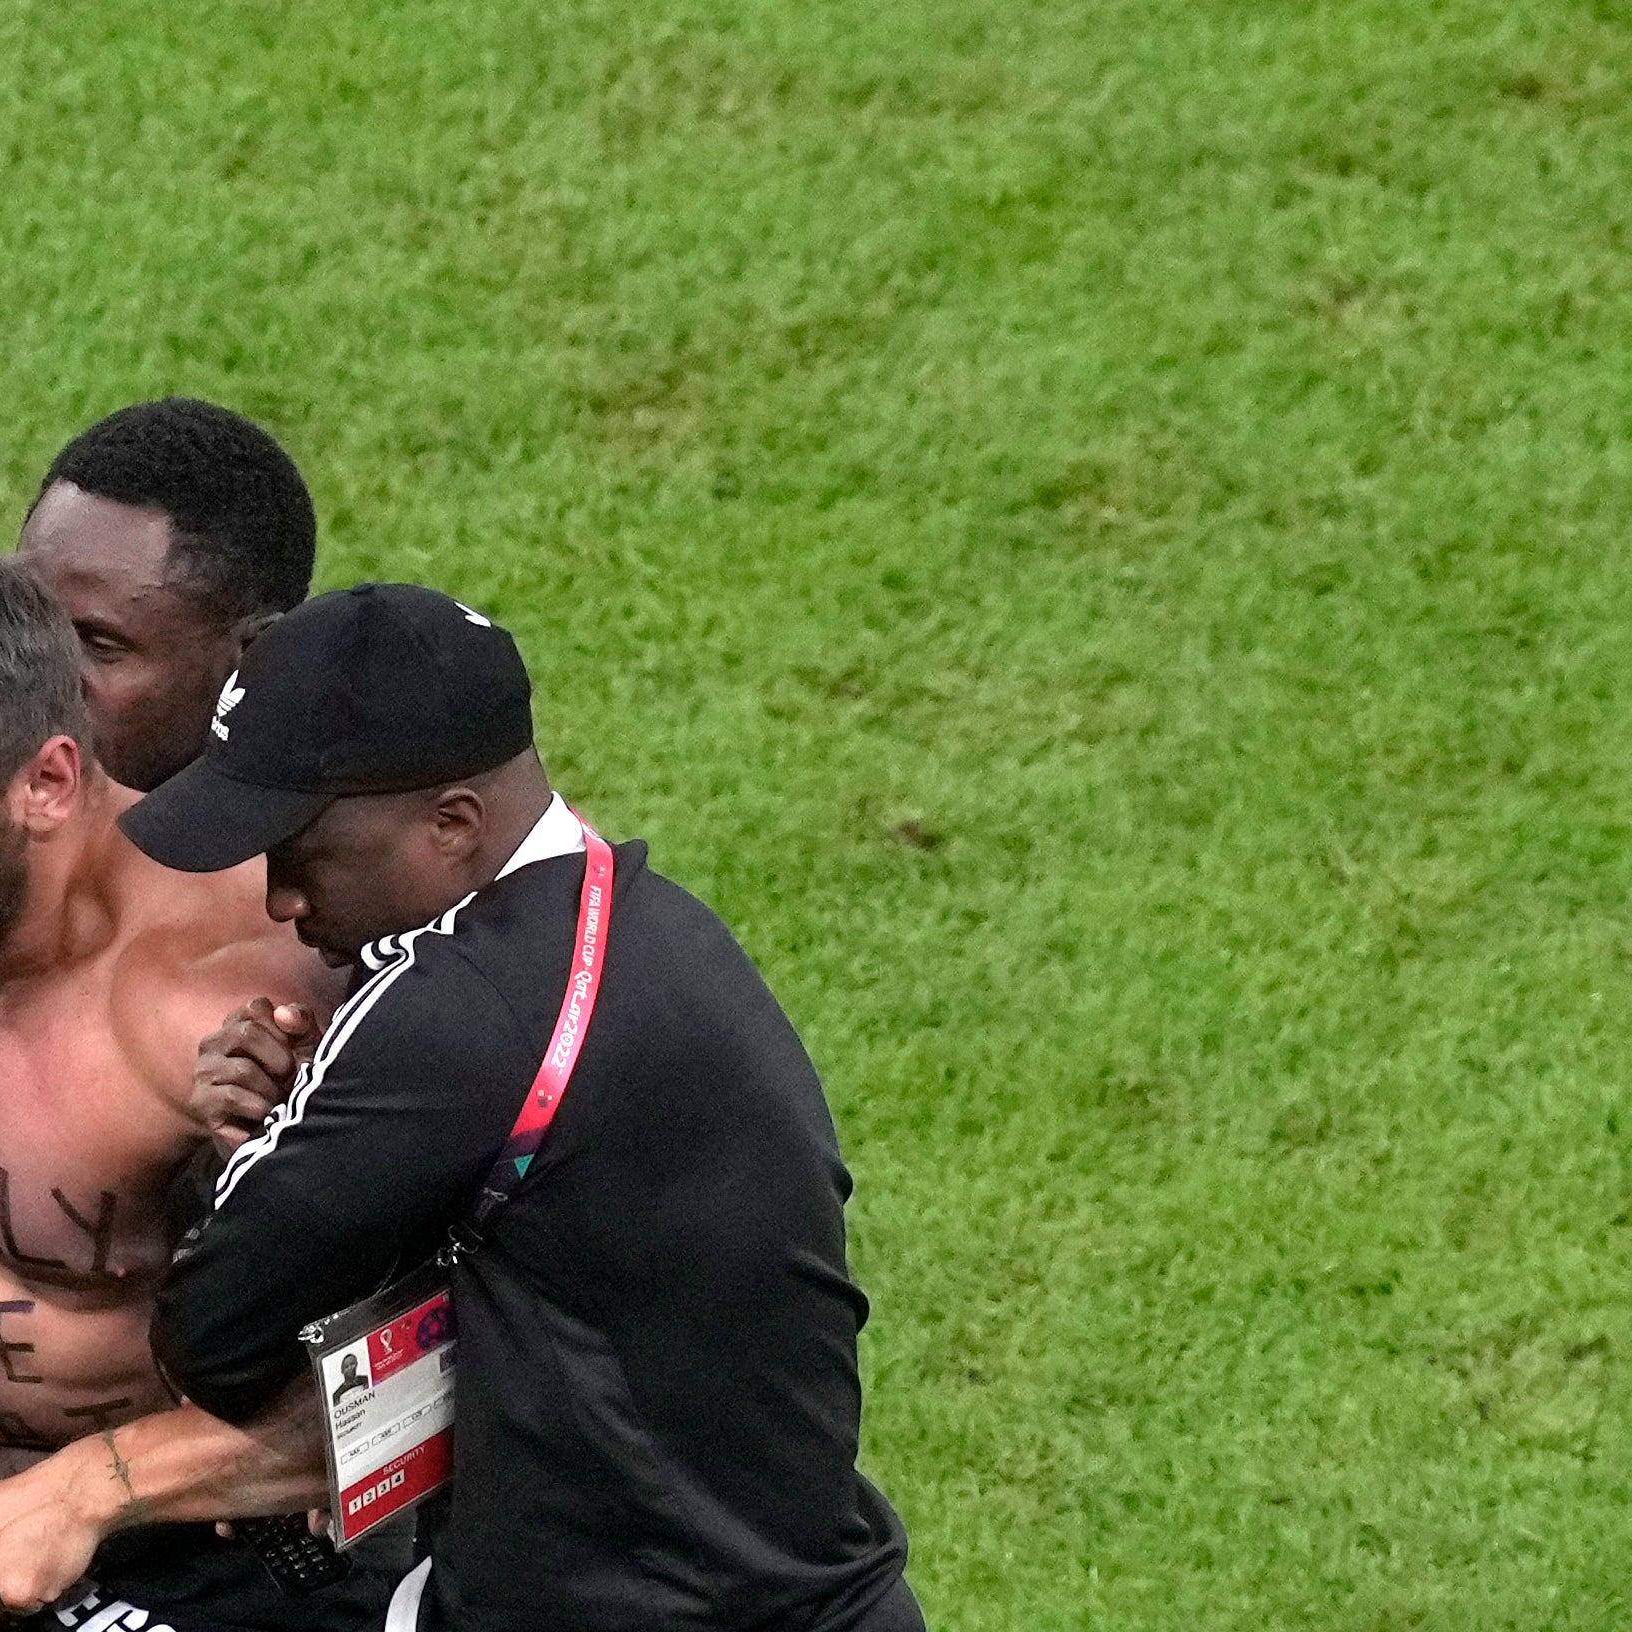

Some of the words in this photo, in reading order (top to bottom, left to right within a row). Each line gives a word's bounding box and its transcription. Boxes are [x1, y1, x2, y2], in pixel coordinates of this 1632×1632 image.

[588, 885, 602, 907] FIFA
[581, 906, 601, 946] WORLD
[333, 1390, 376, 1419] OUSMAN
[382, 1445, 426, 1475] SECURITY
